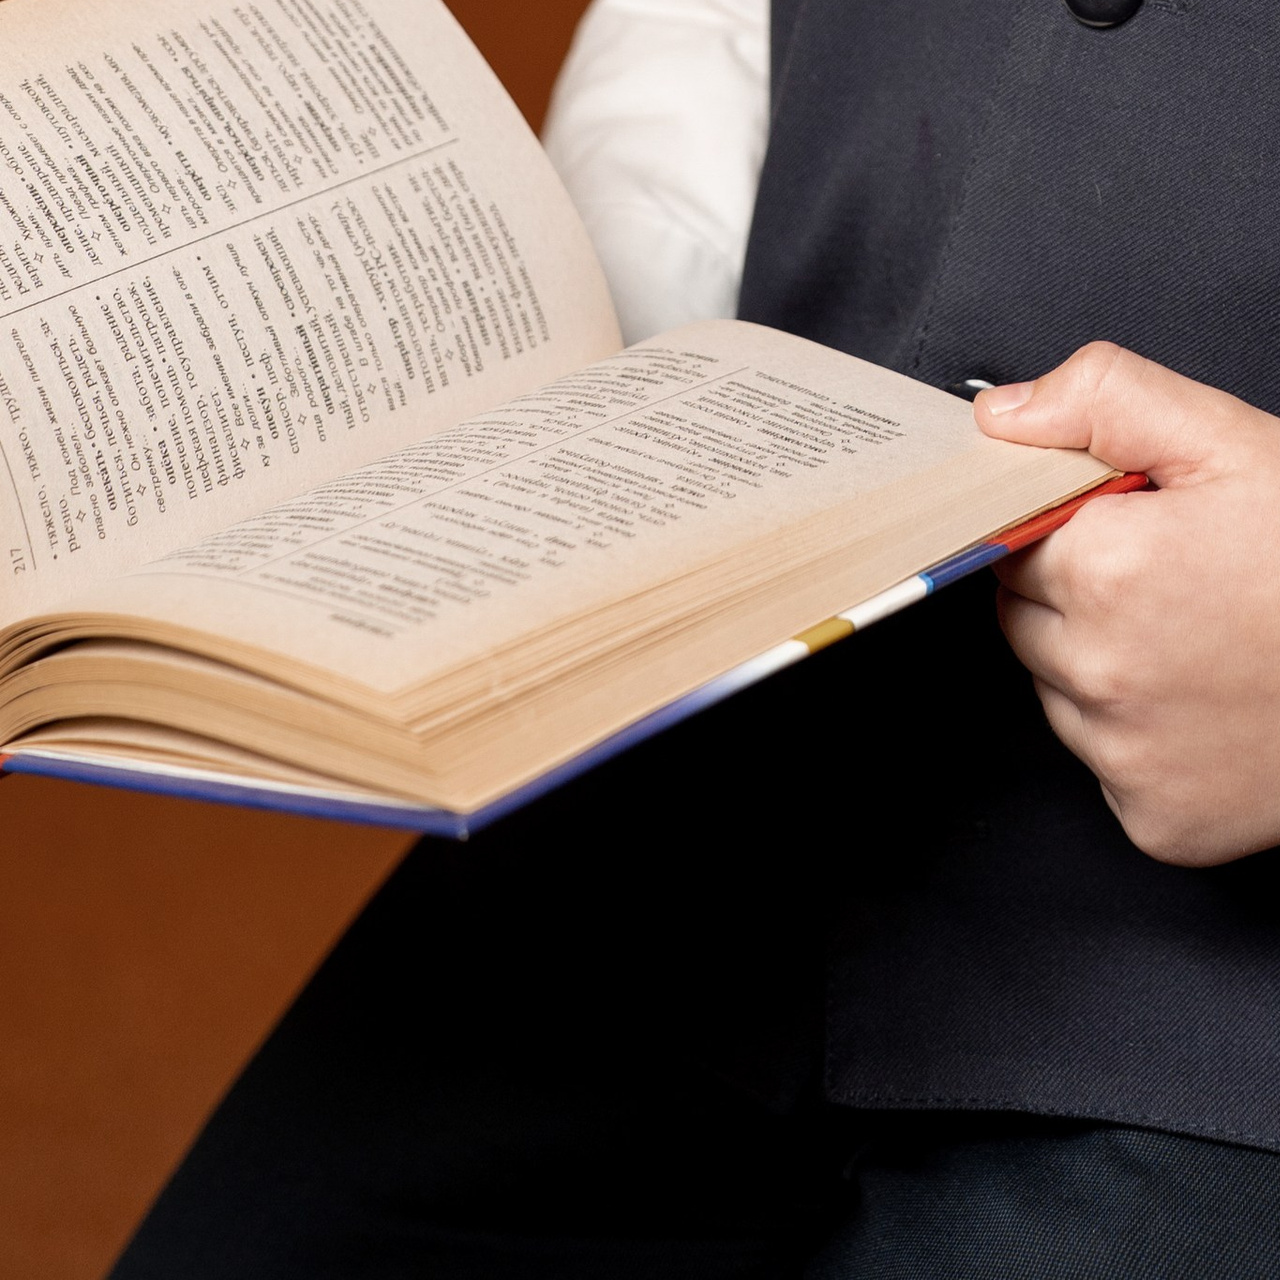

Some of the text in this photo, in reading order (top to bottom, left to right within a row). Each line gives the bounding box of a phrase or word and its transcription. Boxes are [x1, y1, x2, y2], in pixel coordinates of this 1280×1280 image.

[18, 78, 72, 143] шутовской,
[104, 96, 134, 132] похожи
[25, 132, 68, 185] прибывает
[35, 73, 157, 245] поддельный, маскарадный,
[110, 126, 160, 194] Опереточные
[131, 134, 152, 158] века
[17, 141, 103, 266] дение, предварение.
[64, 186, 91, 220] Поезд
[149, 160, 181, 202] первого
[97, 213, 128, 256] жением
[13, 239, 44, 289] варить.
[52, 252, 73, 278] дить
[171, 265, 188, 291] опе-
[201, 265, 229, 309] отчим
[253, 234, 295, 311] своевремен-
[326, 253, 367, 328] оперативный
[359, 258, 387, 304] хирург
[67, 304, 98, 356] больную
[188, 302, 217, 351] забрали
[225, 242, 300, 398] Заботливый опекун лучше
[266, 226, 356, 430] ный, деловитый, успевающий,
[417, 274, 446, 333] Оператор
[10, 327, 41, 383] писатель
[100, 303, 136, 362] радение
[227, 313, 255, 367] пестун,
[343, 314, 364, 352] штабе
[364, 332, 384, 372] только
[379, 278, 435, 394] патологоанатом
[49, 337, 96, 440] беспокоиться,
[93, 358, 120, 407] опекает
[112, 287, 198, 500] попечение, попечительство,
[126, 281, 213, 493] шефская помощь патронаж,
[131, 364, 157, 422] забота,
[142, 275, 234, 486] финнадзор, госуправление,
[212, 353, 236, 400] имение
[323, 309, 370, 423] ответственный.
[36, 385, 58, 425] жизни
[258, 348, 300, 454] спонсор, шеф.
[53, 426, 72, 466] конец
[68, 333, 139, 527] ботиться, печься, радеть.
[115, 409, 135, 449] нежно
[210, 386, 246, 480] фискалитет.
[18, 426, 59, 550] тяжело, тяжко,
[58, 494, 81, 553] рьезно.
[89, 493, 106, 540] опасно
[9, 546, 26, 576] 217
